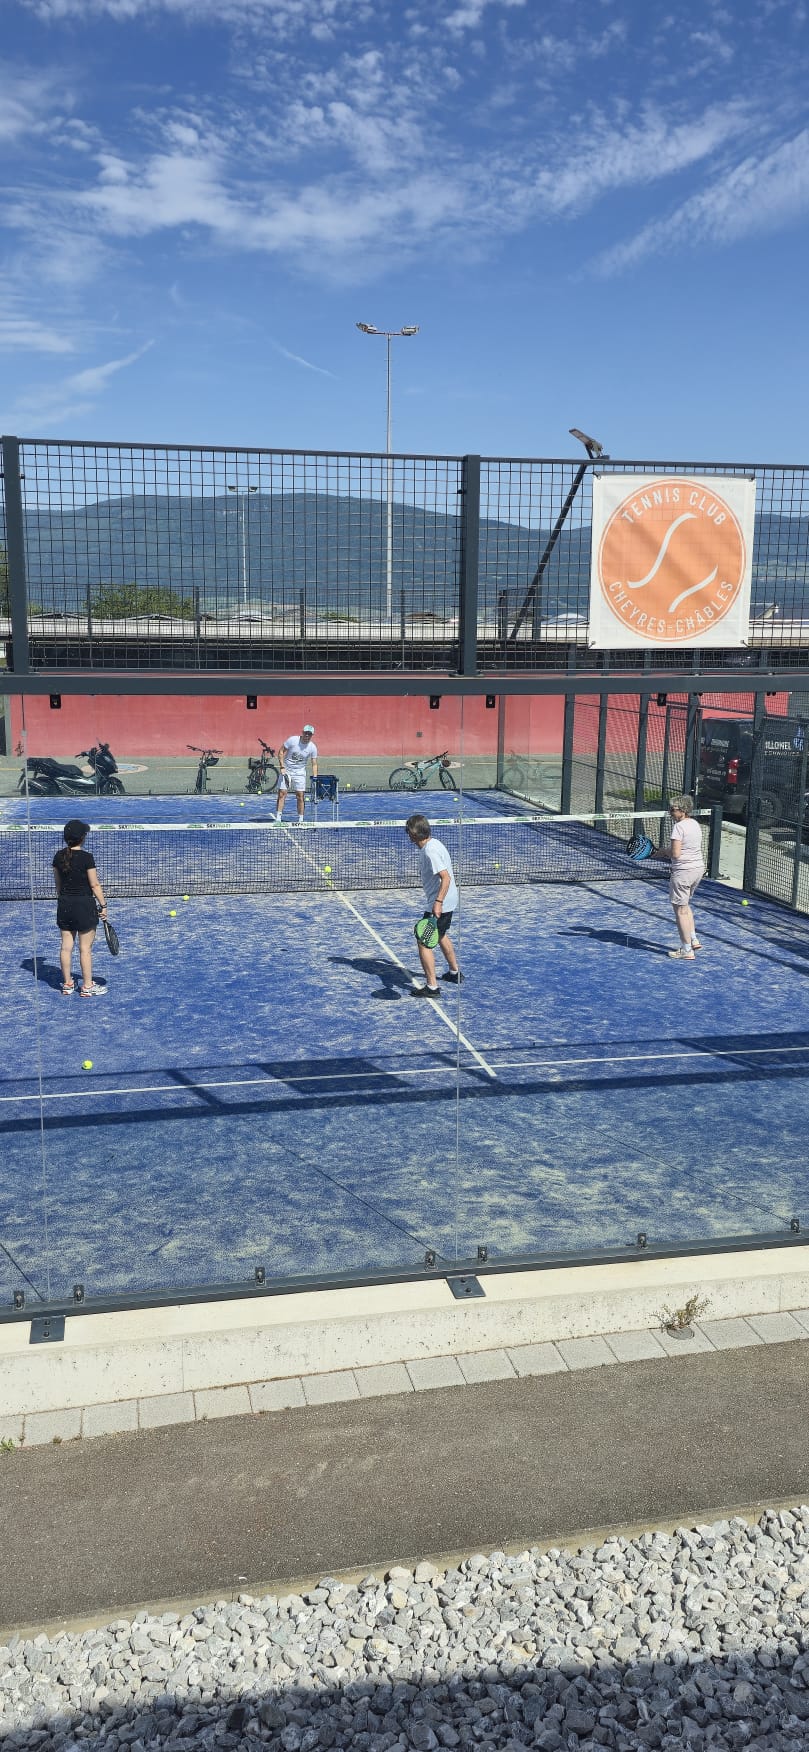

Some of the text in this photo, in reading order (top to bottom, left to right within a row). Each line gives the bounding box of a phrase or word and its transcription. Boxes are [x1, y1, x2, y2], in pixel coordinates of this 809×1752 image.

[621, 487, 727, 525] TENNIS CLUB
[609, 581, 733, 633] CHEYRES-CHÂBLES
[764, 741, 792, 750] ILLONEL
